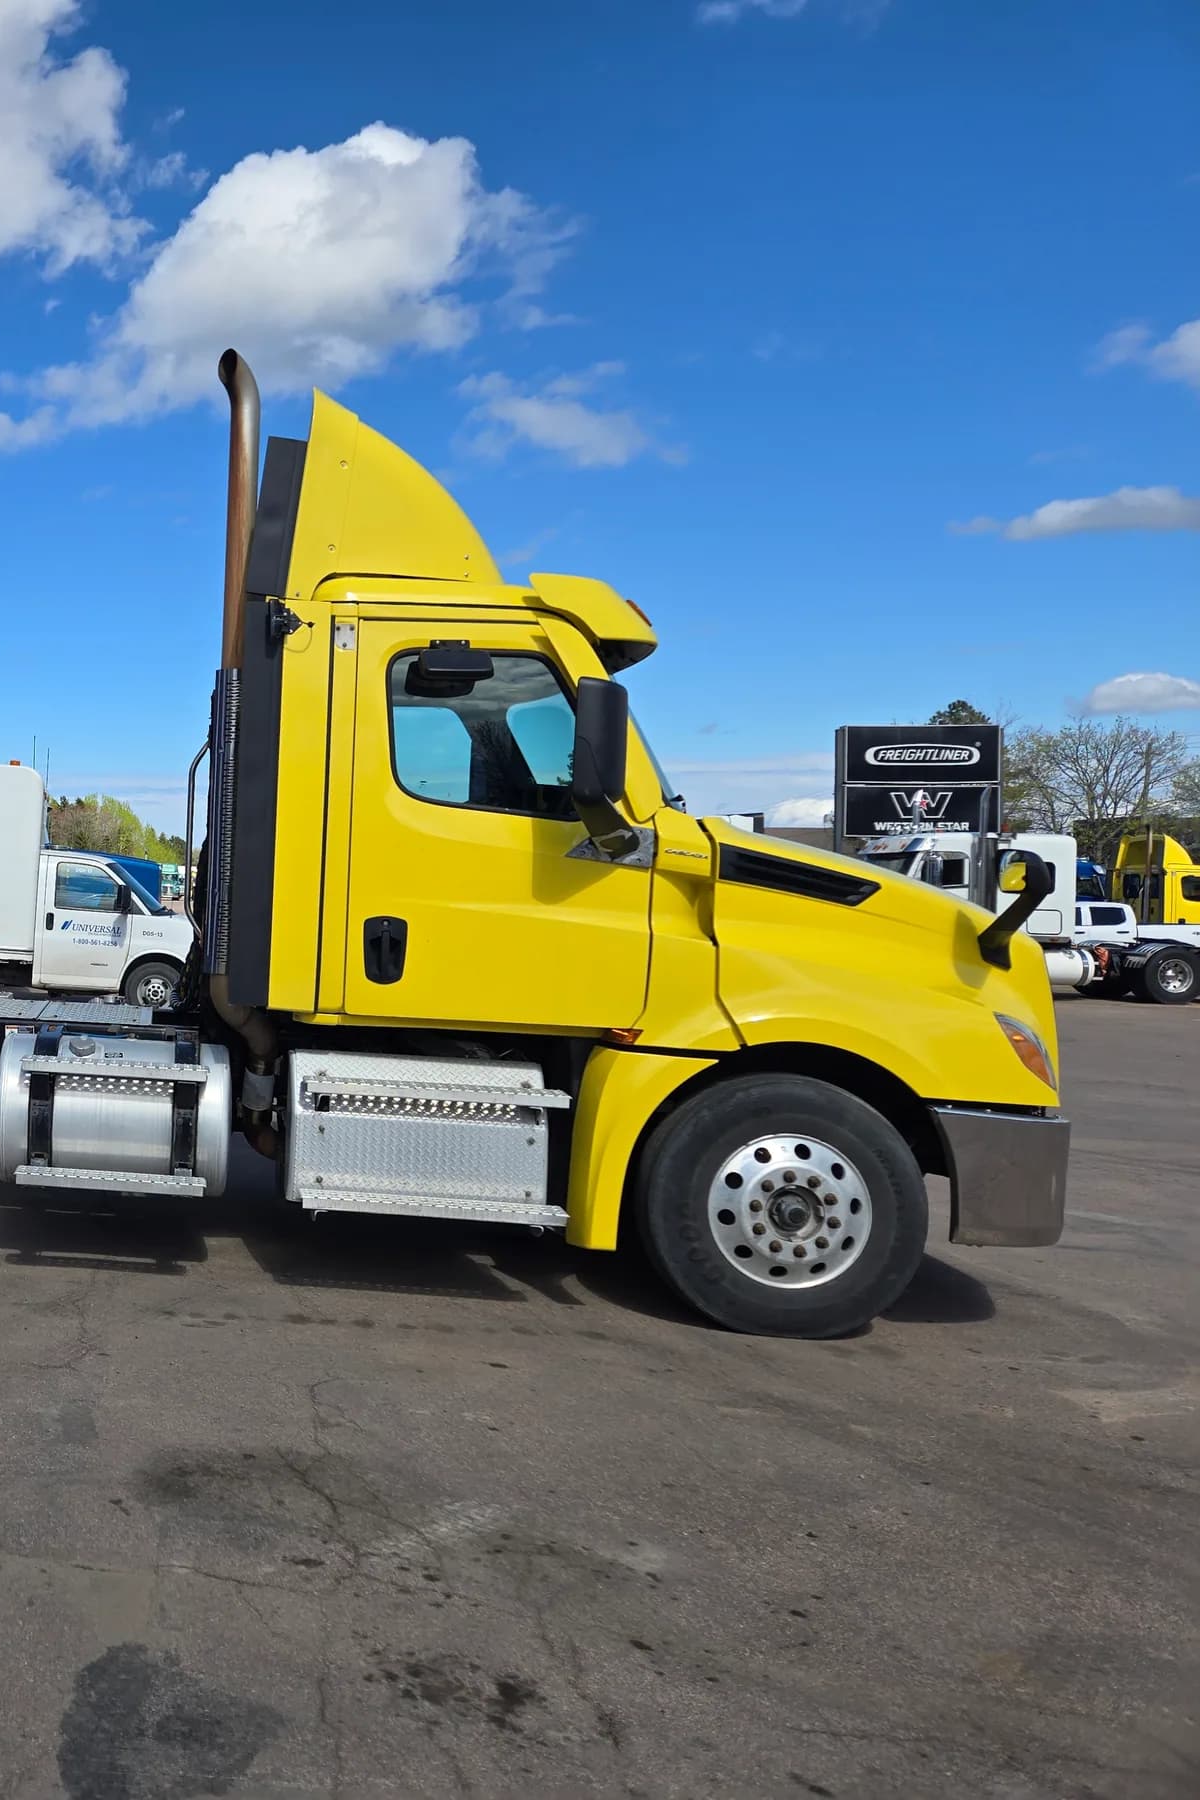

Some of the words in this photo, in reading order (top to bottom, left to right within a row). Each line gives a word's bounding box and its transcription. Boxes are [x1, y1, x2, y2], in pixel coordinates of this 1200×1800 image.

[877, 748, 970, 761] FREIGHTLINER
[937, 821, 970, 831] STAR
[72, 923, 122, 935] UNIVERSAL
